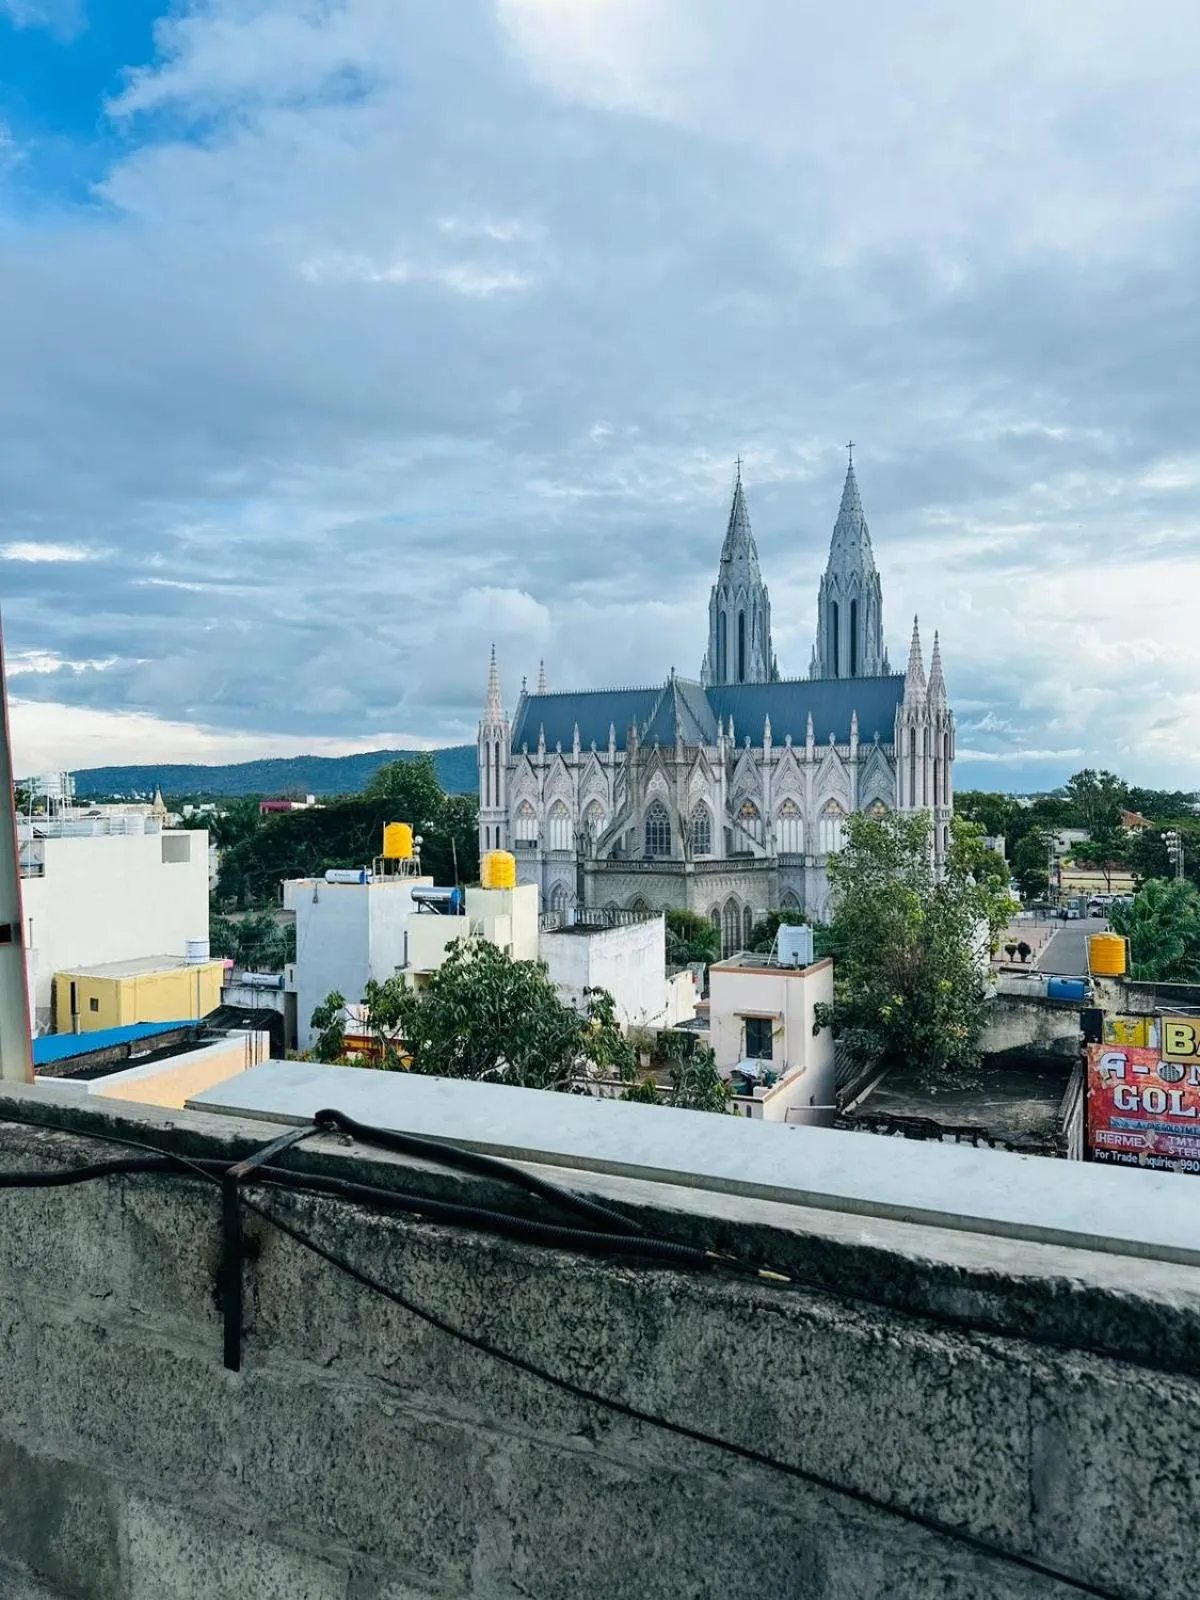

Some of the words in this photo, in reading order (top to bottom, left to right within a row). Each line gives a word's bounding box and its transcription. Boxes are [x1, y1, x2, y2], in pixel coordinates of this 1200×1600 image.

[1165, 1022, 1200, 1056] B
[1113, 1084, 1200, 1118] GOL
[1095, 1149, 1109, 1159] For
[1111, 1150, 1137, 1163] Trade
